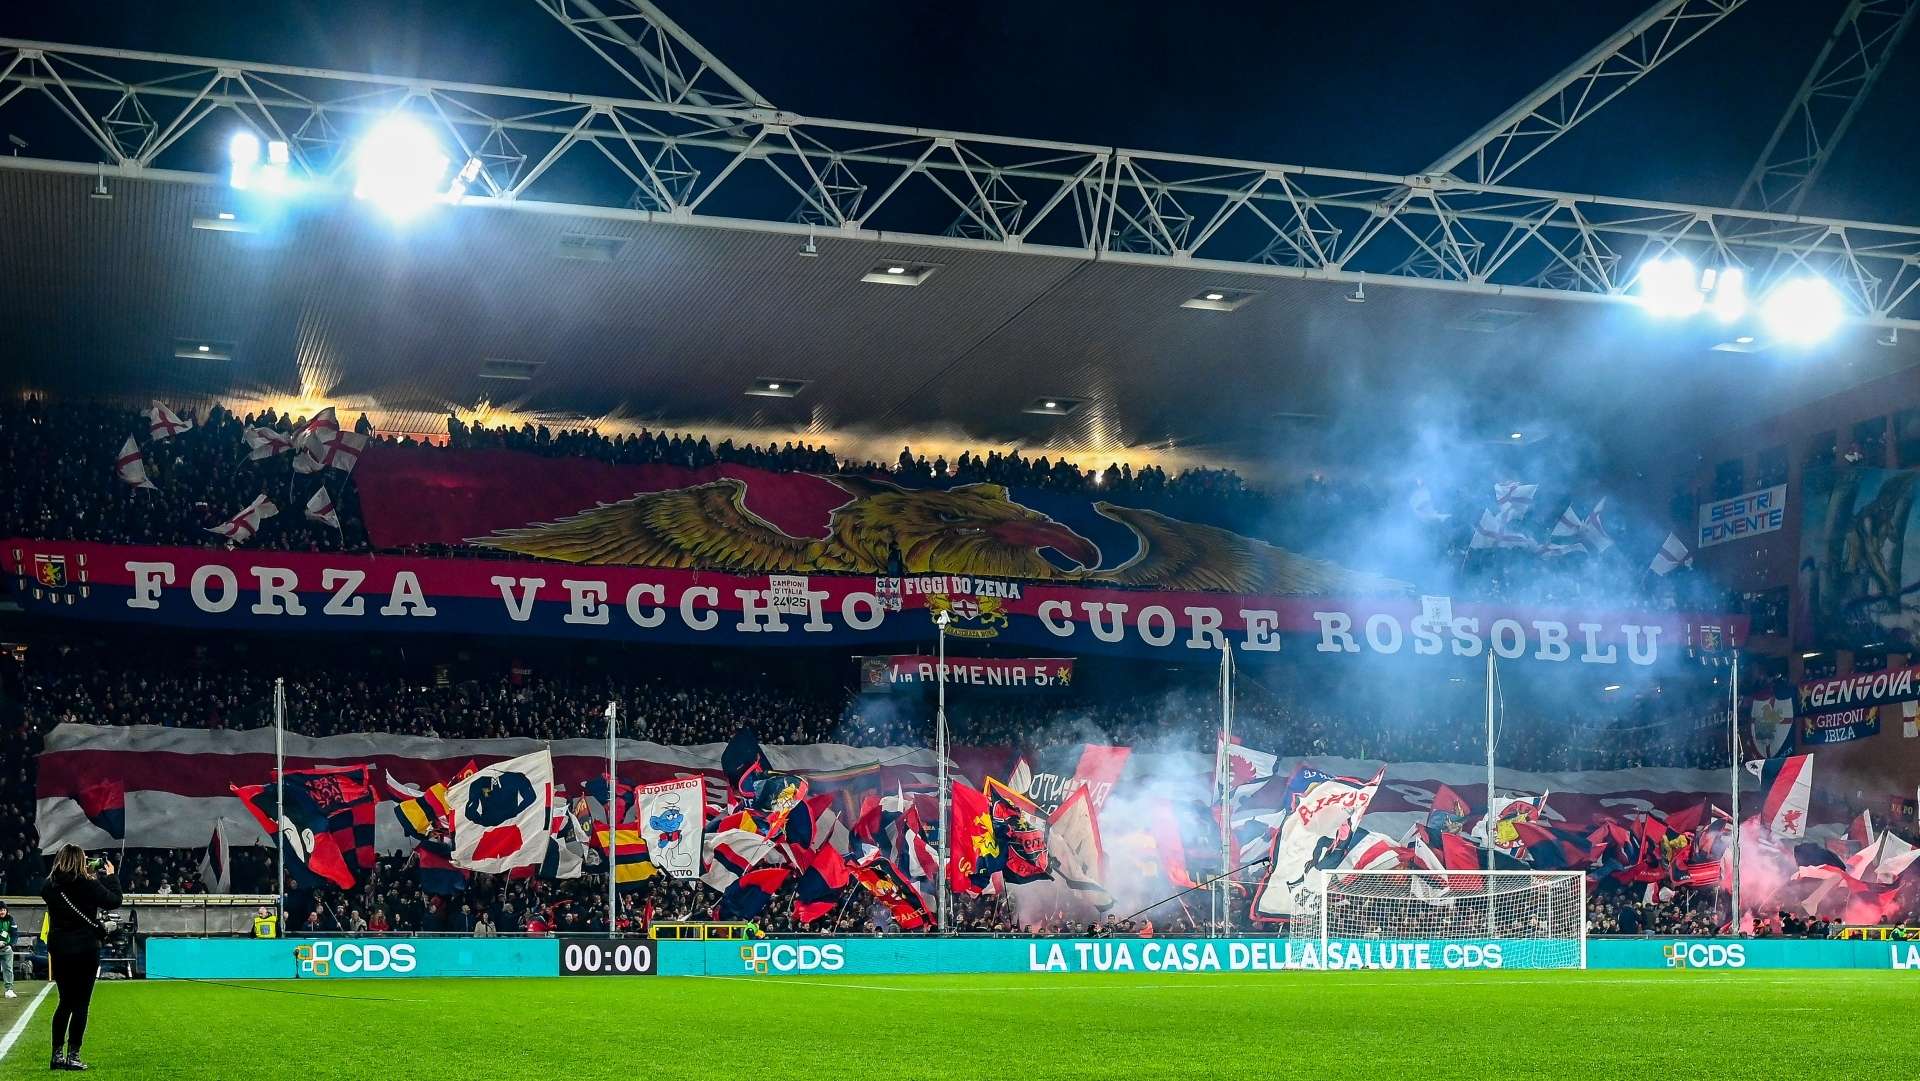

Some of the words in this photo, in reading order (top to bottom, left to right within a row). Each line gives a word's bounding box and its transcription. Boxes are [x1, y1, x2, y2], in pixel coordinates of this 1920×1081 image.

[1711, 491, 1773, 522] SESTRI
[1702, 508, 1783, 545] PONENTE
[772, 580, 805, 588] CAMPIONI
[775, 587, 803, 595] D'ITALIA
[904, 577, 949, 595] FIGGI
[952, 577, 972, 595] DO
[975, 578, 1021, 600] ZENA
[125, 561, 437, 617] FORZA
[490, 576, 885, 633] VECCHIO
[1038, 599, 1282, 653] CUORE
[1313, 611, 1663, 666] ROSSOBLU
[918, 663, 1027, 687] ARMENIA
[1816, 708, 1865, 728] GRIFONI
[1824, 726, 1856, 743] IBIZA
[333, 943, 417, 973] CDS
[563, 943, 652, 973] 00:00
[771, 943, 845, 971] CDS
[1028, 943, 1068, 971] LA
[1075, 943, 1135, 971] TUA
[1142, 943, 1222, 971] CASA
[1229, 943, 1319, 970] DELLA
[1327, 943, 1431, 970] SALUTE
[1443, 944, 1503, 968] CDS
[1688, 943, 1746, 968] CDS
[1891, 944, 1920, 970] LA
